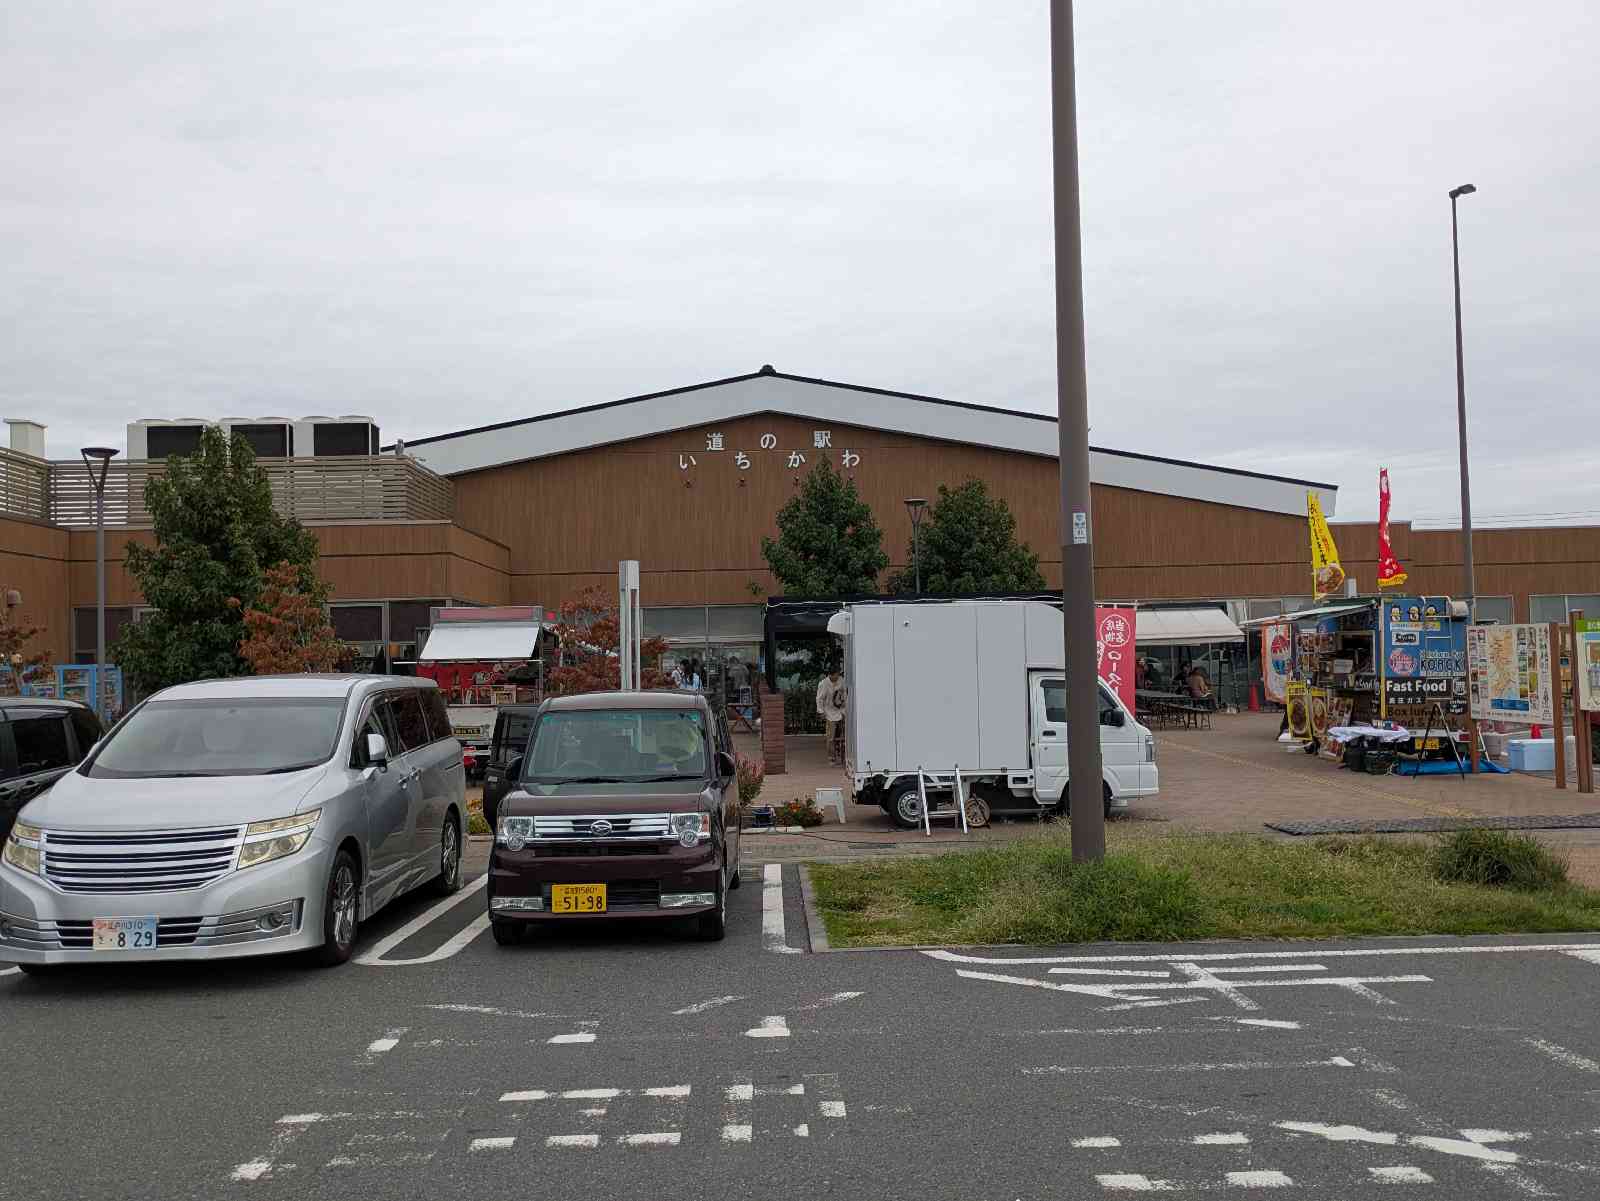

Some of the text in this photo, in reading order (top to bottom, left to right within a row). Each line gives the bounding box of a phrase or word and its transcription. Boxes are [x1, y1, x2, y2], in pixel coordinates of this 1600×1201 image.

[706, 430, 832, 451] 道の駅
[678, 449, 861, 469] いちかわ
[1386, 679, 1413, 692] Fast
[1415, 679, 1447, 692] Food
[563, 896, 603, 910] 51-98
